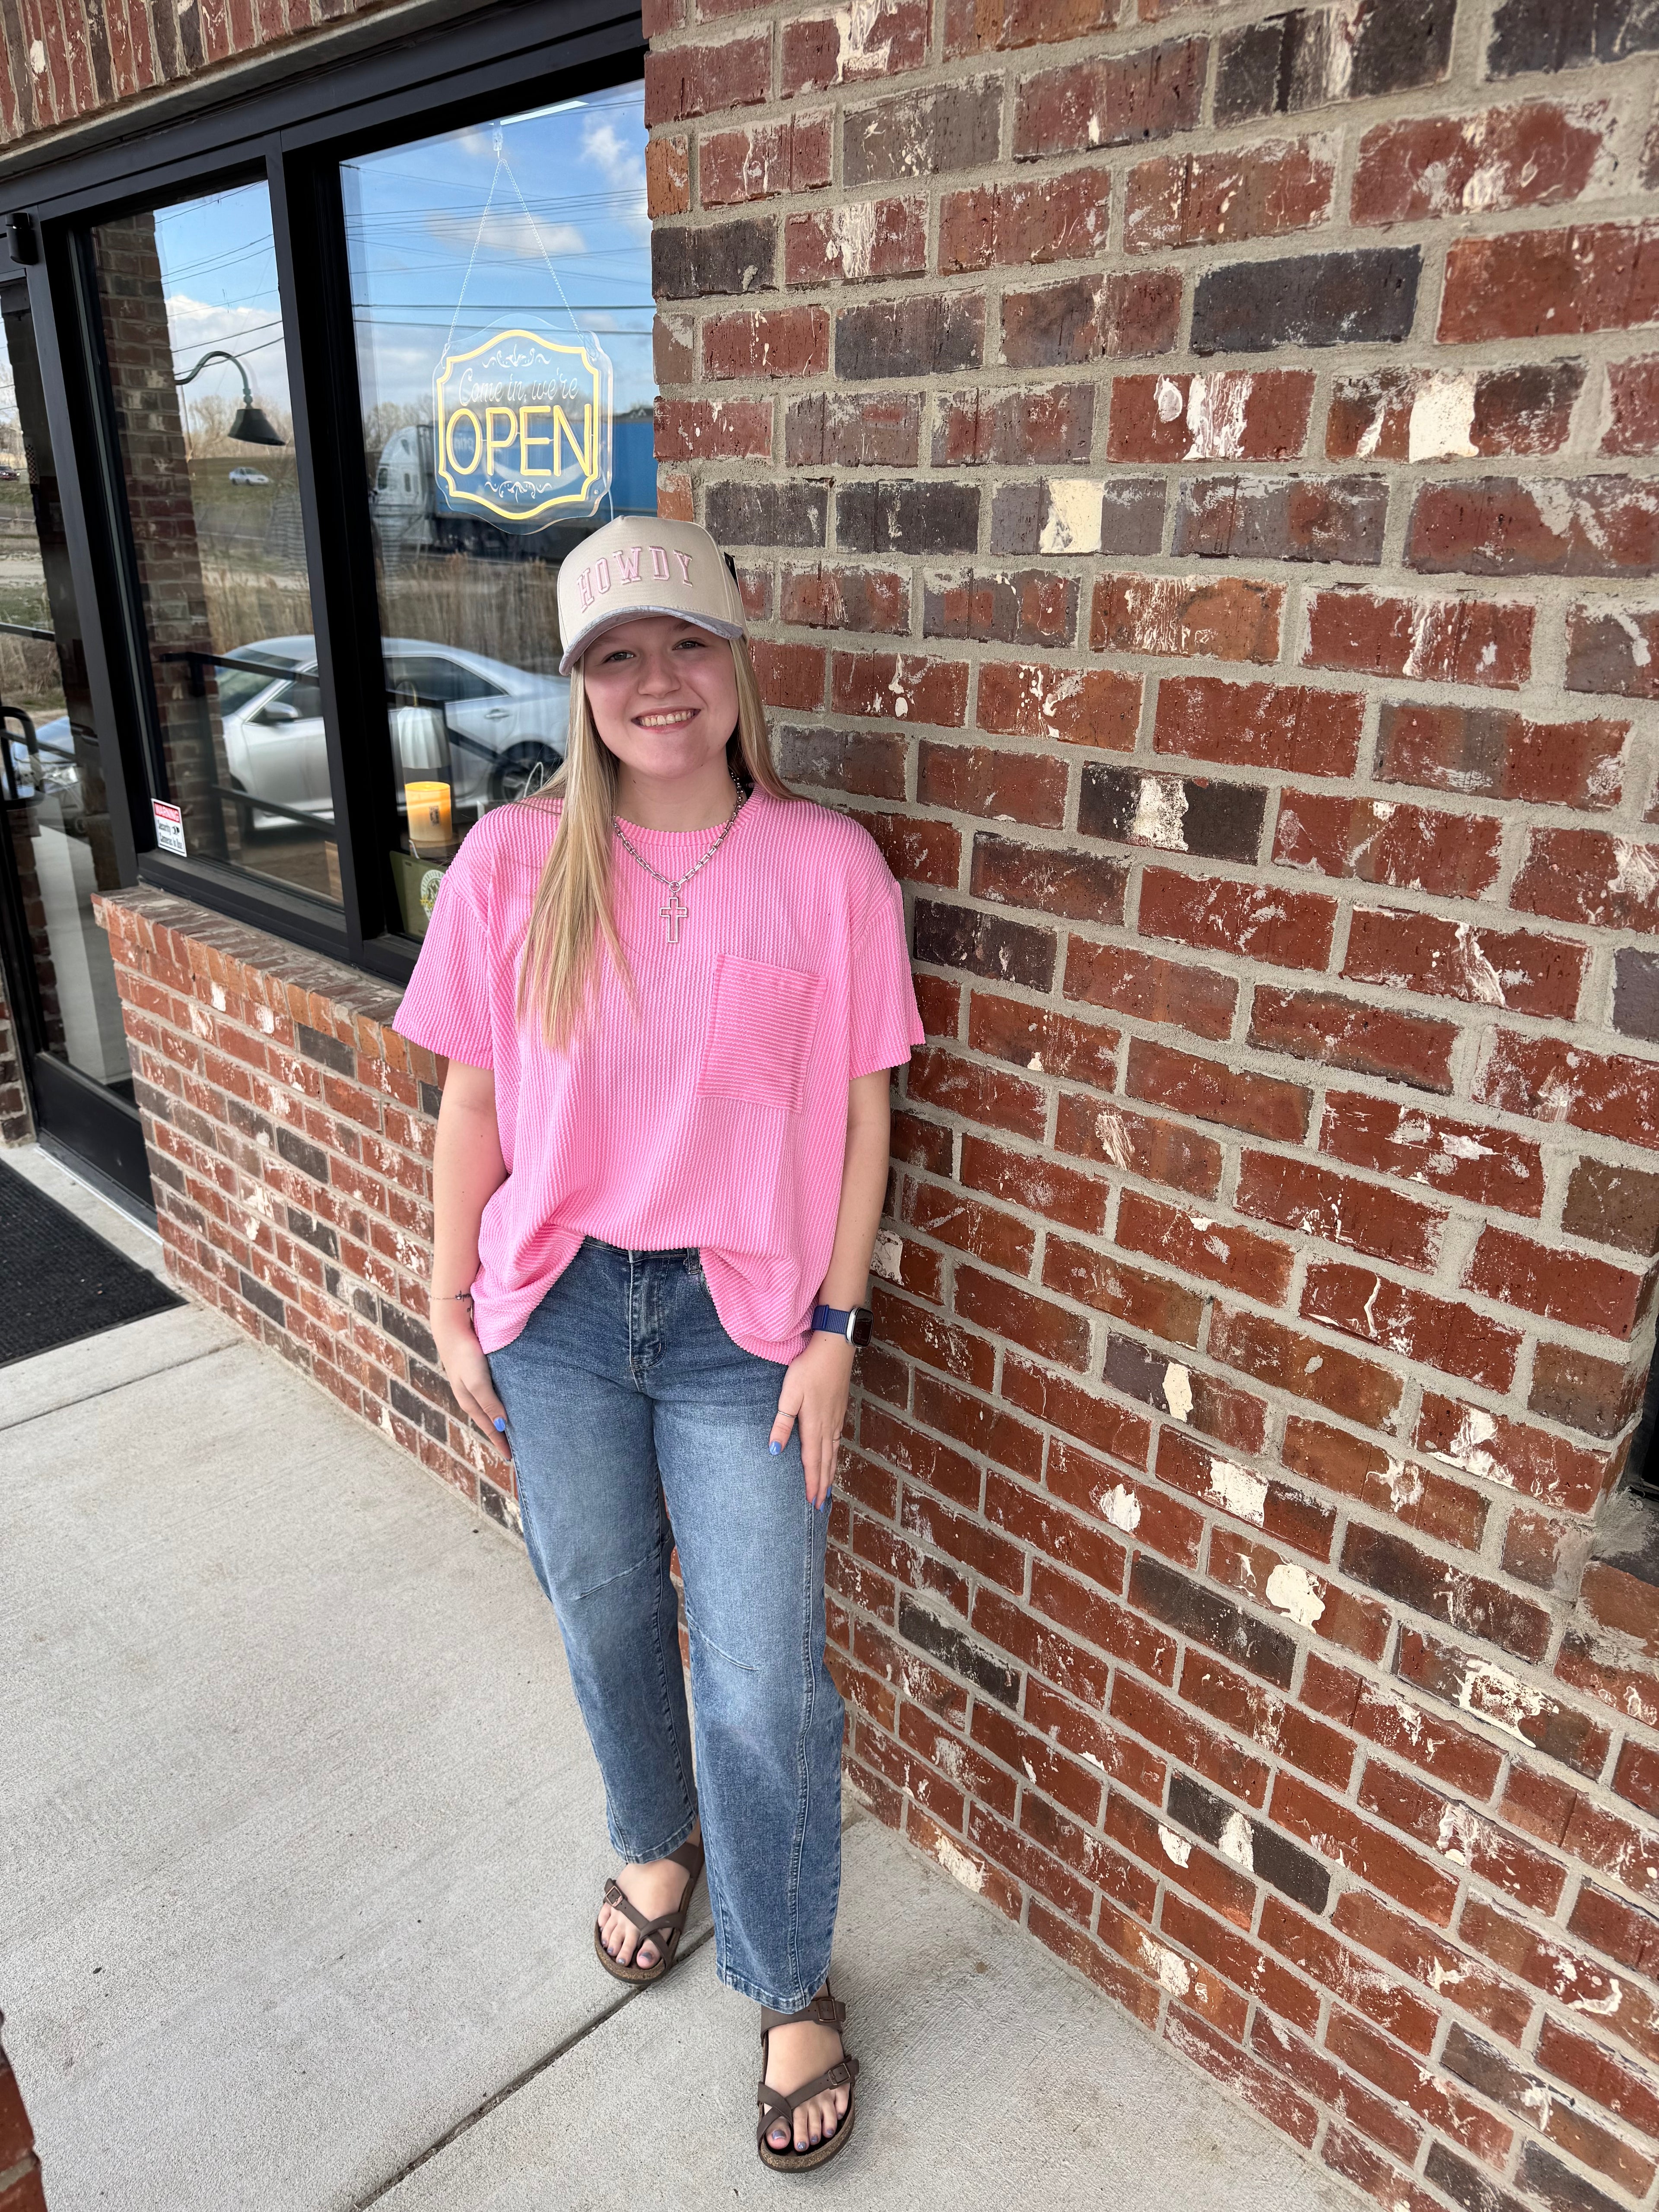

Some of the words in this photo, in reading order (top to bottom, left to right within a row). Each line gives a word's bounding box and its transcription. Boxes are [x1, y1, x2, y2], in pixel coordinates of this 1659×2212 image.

[459, 367, 504, 406] Come
[508, 374, 526, 402] in,
[532, 367, 579, 401] we're
[446, 404, 592, 477] OPEN
[576, 546, 693, 613] HOWDY
[155, 803, 180, 822] WARNING
